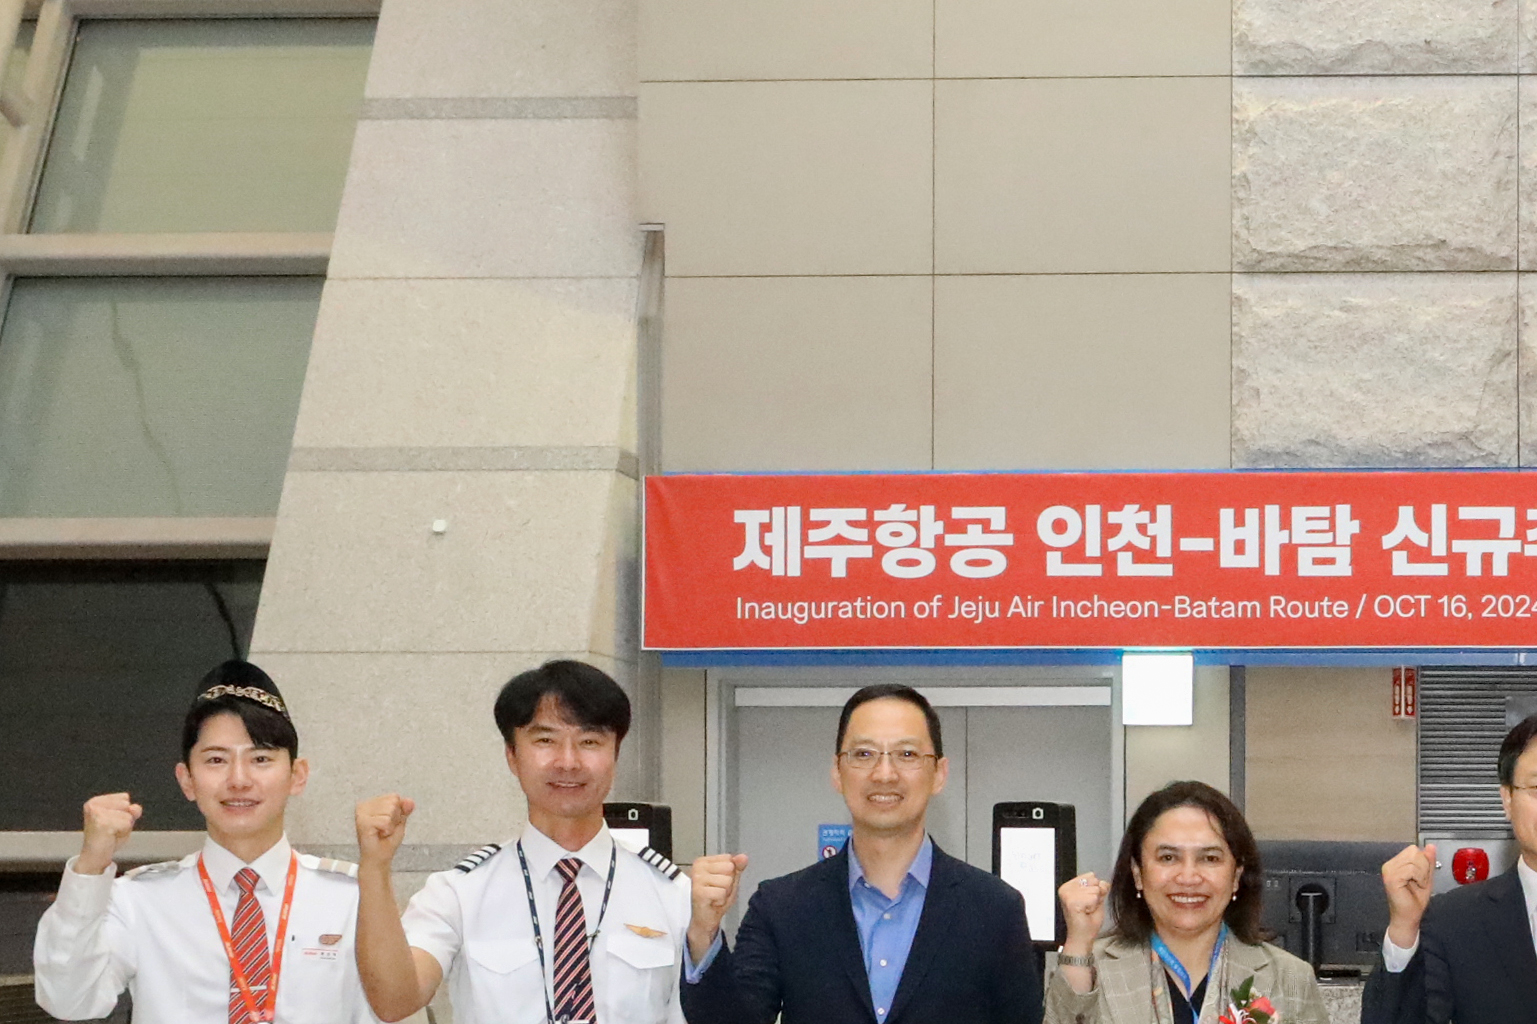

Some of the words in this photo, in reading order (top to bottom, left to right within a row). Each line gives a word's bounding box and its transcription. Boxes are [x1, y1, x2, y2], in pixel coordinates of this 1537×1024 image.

[734, 503, 1013, 578] 제주항공
[1037, 503, 1361, 577] 인천-바탐
[737, 595, 905, 624] Inauguration
[913, 595, 943, 618] of
[948, 596, 1000, 624] Jeju
[1007, 595, 1045, 618] Air
[1052, 595, 1261, 618] Incheon-Batam
[1269, 595, 1349, 618] Route
[1374, 595, 1432, 618] OCT
[1438, 595, 1473, 621] 16,
